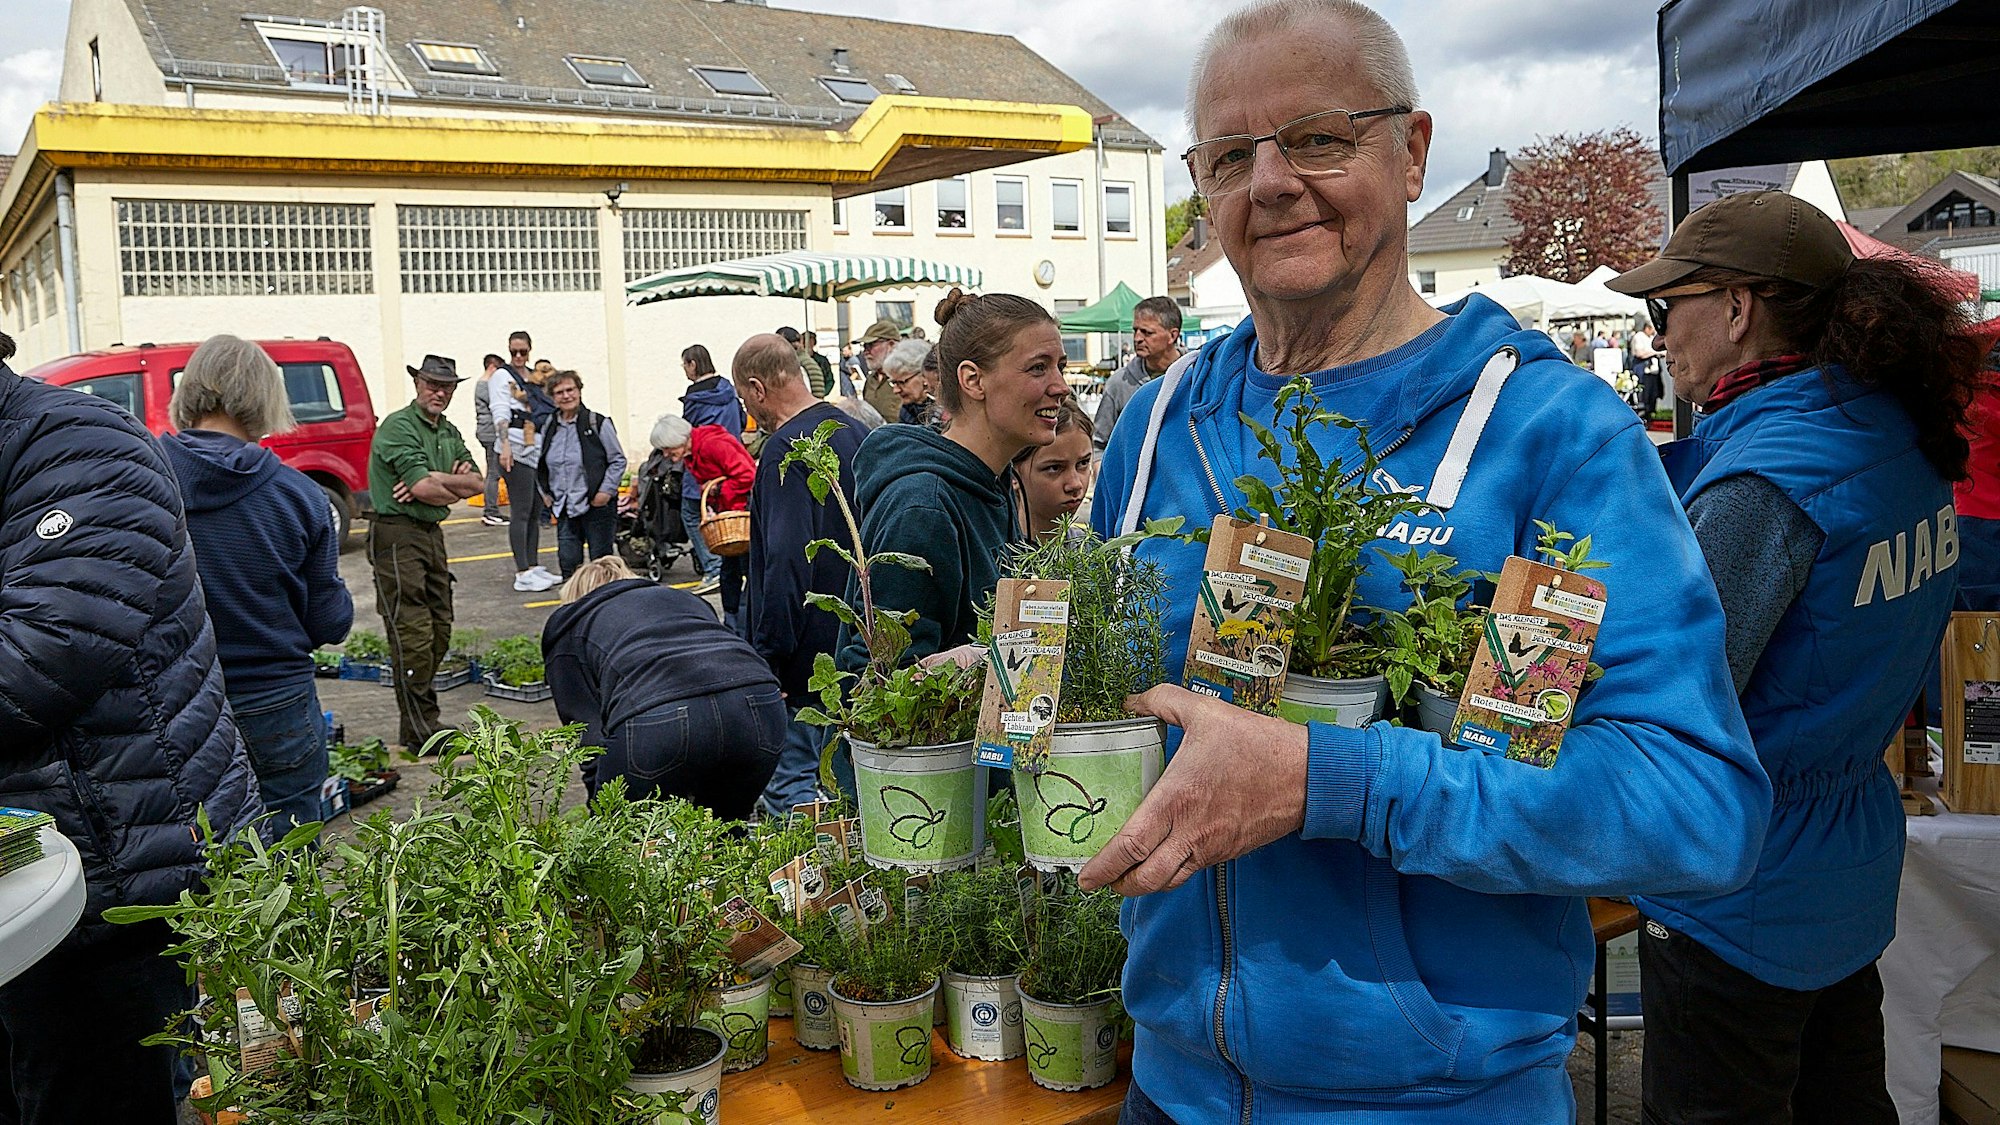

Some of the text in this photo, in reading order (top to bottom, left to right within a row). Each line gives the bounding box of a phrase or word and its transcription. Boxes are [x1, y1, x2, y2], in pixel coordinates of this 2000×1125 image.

[1223, 572, 1254, 582] KLEINSTE
[1242, 592, 1294, 610] DEUTSCHLANDS
[1499, 613, 1545, 625] DAS KLEINSTE
[1531, 634, 1587, 653] DEUTSCHLANDS
[1198, 651, 1260, 675] Wiesen-Pippau
[1191, 684, 1221, 698] NABU
[1473, 696, 1543, 719] Rote Lichtnelke
[1004, 713, 1026, 722] Echtes
[1007, 723, 1036, 732] Labkraut
[1462, 730, 1496, 746] NABU
[980, 751, 1004, 761] NABU
